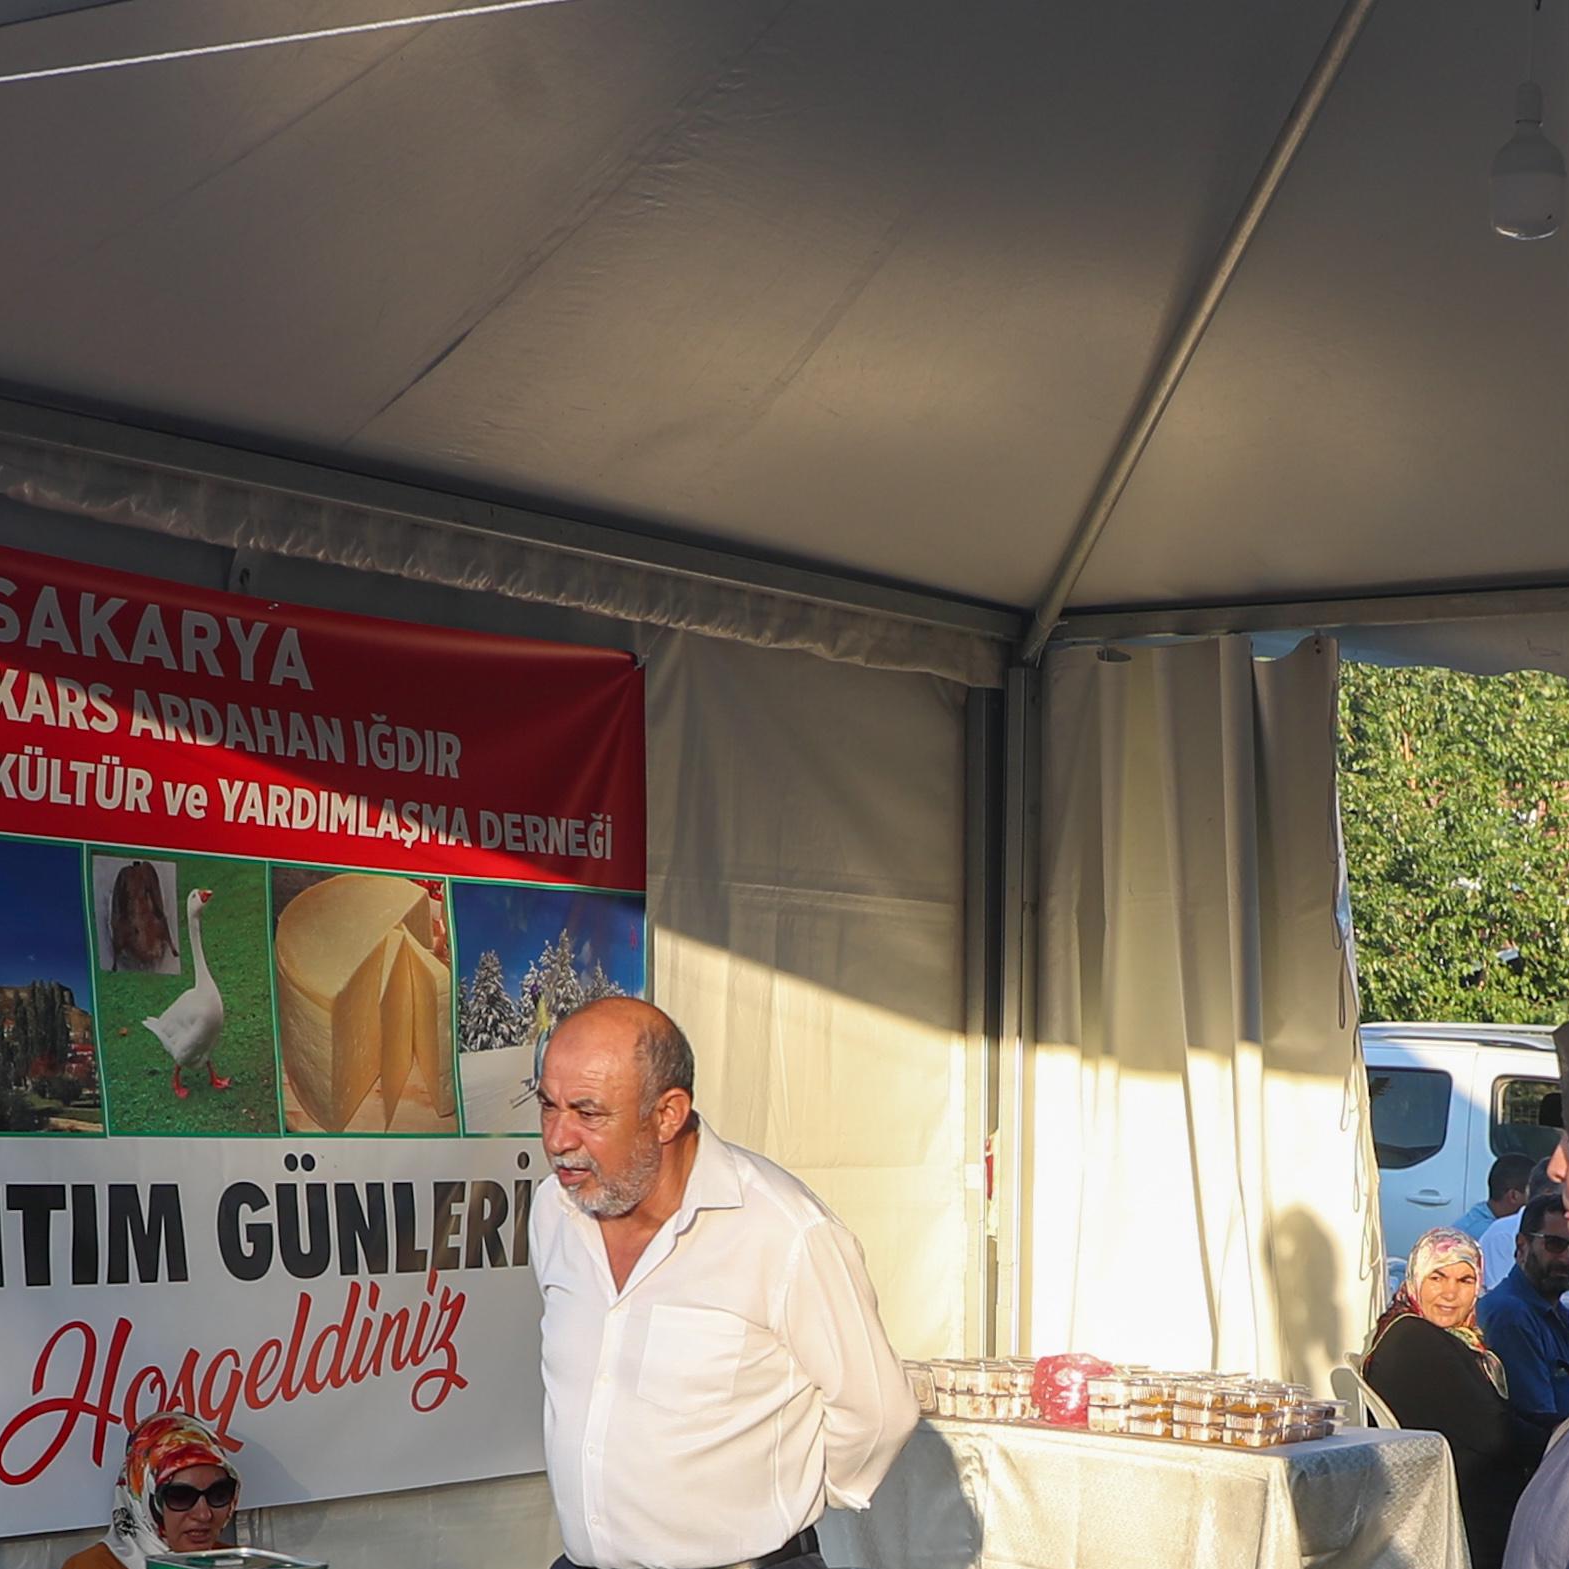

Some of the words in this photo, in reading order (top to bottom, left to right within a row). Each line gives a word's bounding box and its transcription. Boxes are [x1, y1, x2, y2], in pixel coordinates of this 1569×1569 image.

[129, 692, 352, 762] ARDAHAN
[355, 712, 462, 779] IĞDIR
[165, 782, 209, 820] ve
[218, 779, 470, 848] YARDIMLAŞMA
[478, 810, 613, 861] DERNEĞİ
[216, 1150, 543, 1284] GÜNLERİ
